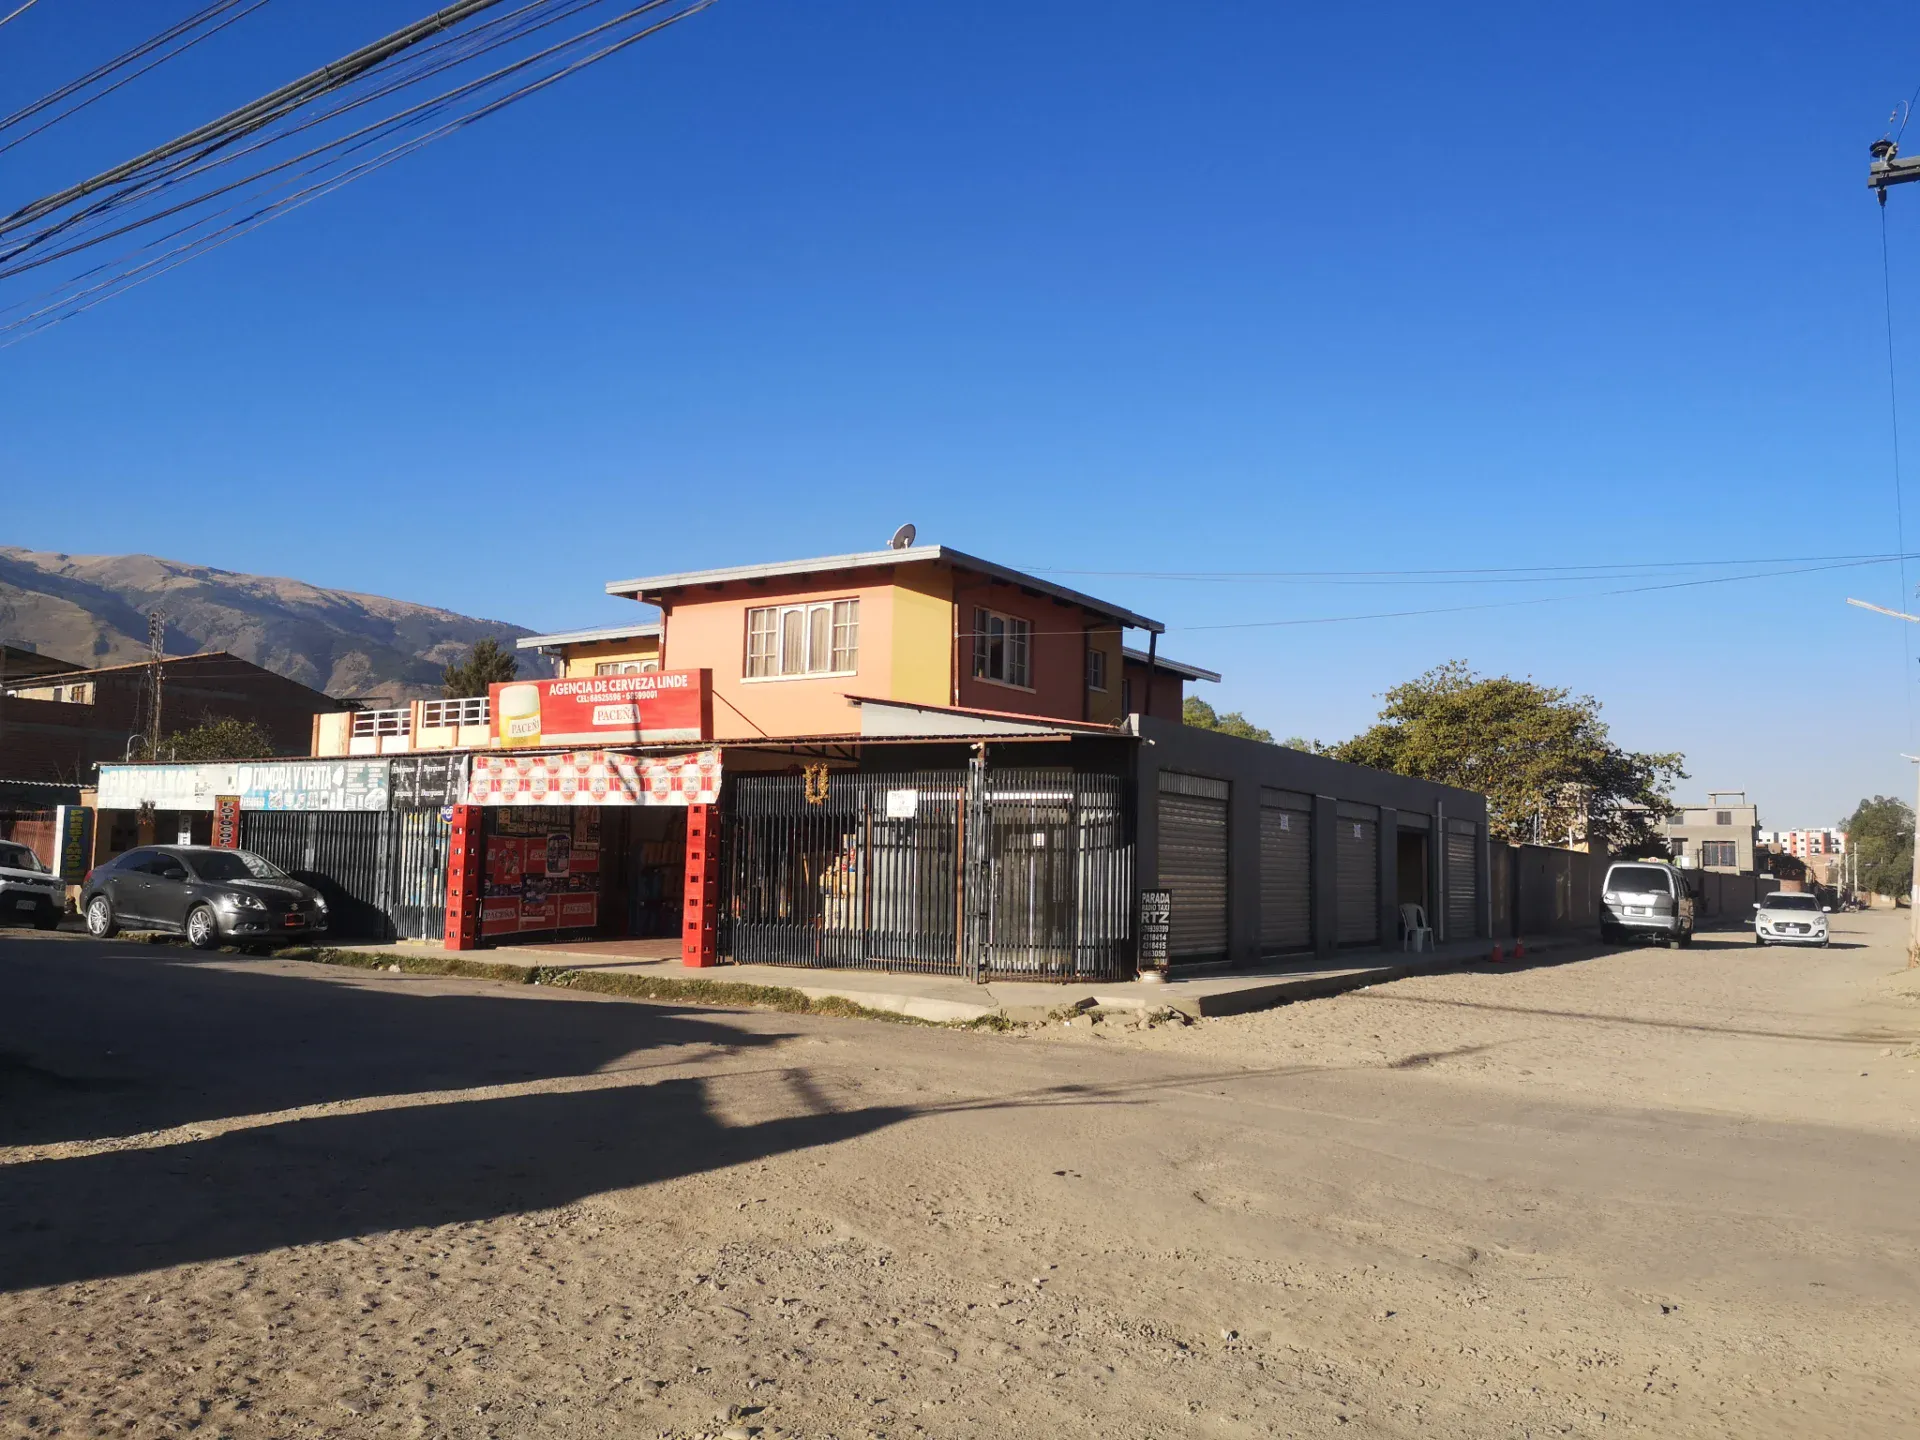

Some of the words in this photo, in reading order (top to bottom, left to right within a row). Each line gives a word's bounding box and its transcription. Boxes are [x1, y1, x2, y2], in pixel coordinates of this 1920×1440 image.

[549, 682, 593, 696] AGENCIA
[594, 680, 607, 693] DE
[608, 677, 655, 692] CERVEZA
[657, 674, 688, 688] LINDE
[597, 706, 638, 721] PACEÑA
[253, 767, 291, 790] COMPRA
[293, 766, 301, 789] Y
[301, 765, 332, 789] VENTA
[1141, 892, 1170, 904] PARADA
[1141, 911, 1170, 924] RTZ
